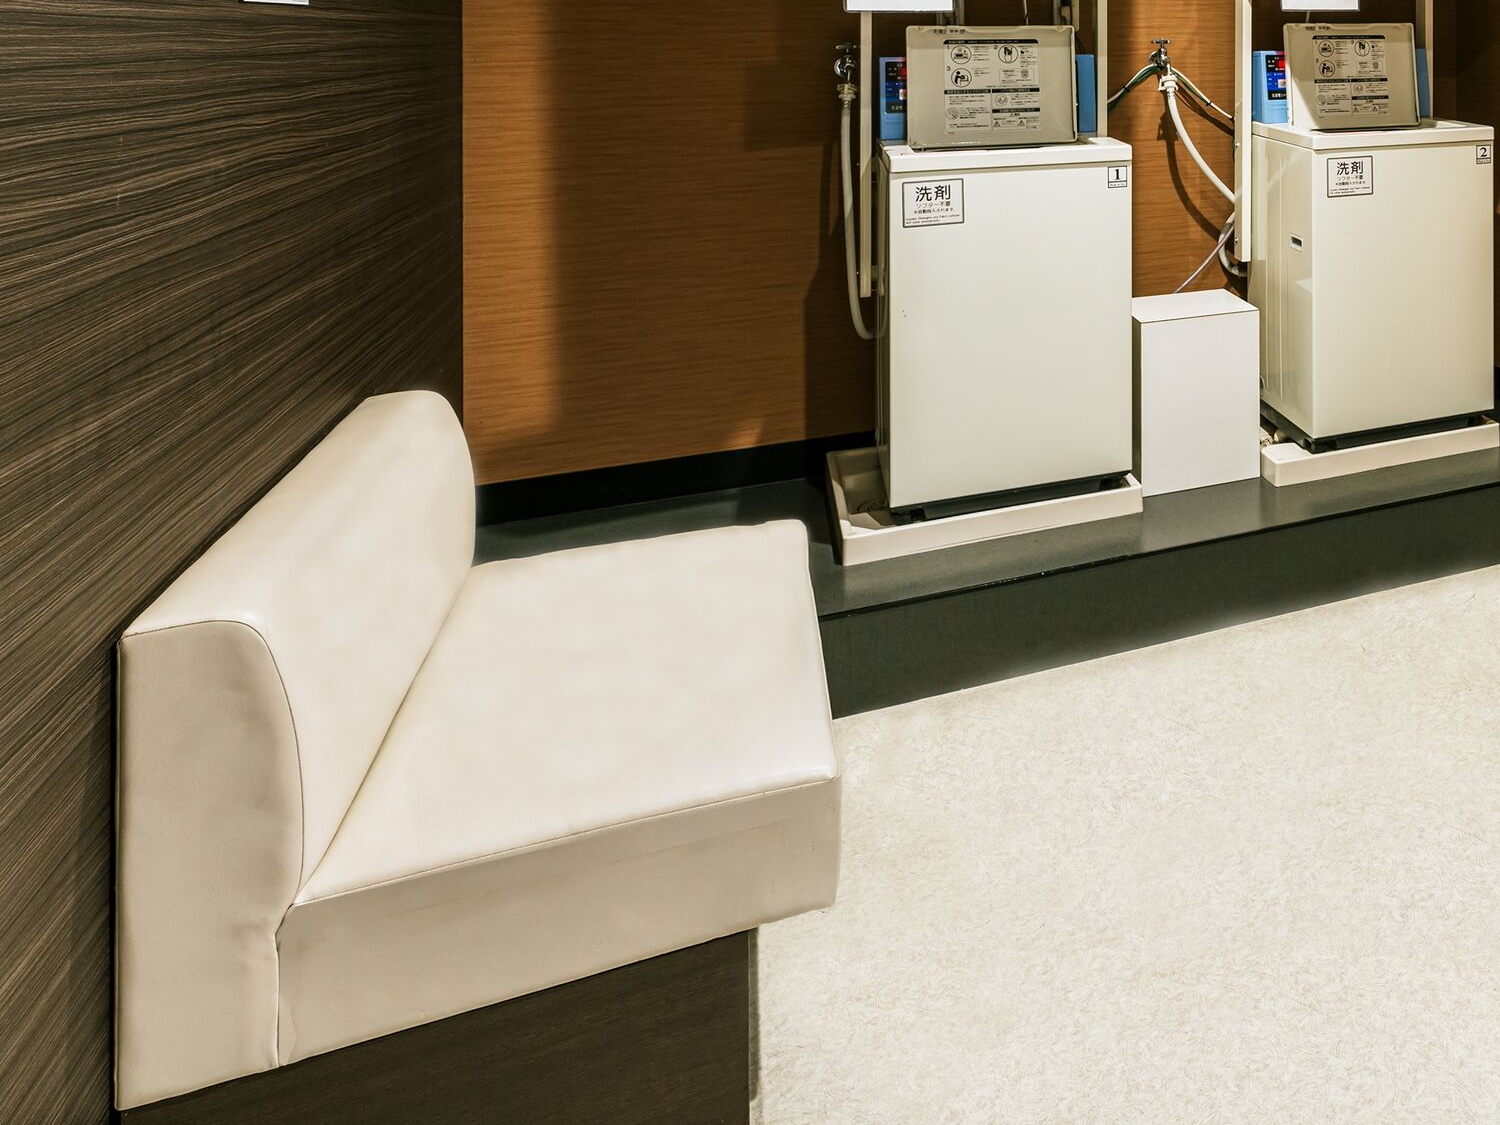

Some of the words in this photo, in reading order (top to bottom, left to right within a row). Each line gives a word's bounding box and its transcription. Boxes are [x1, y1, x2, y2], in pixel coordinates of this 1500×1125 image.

[1479, 146, 1488, 158] 2
[1114, 168, 1121, 181] 1
[1336, 160, 1364, 176] 洗剤
[915, 184, 951, 203] 洗剤
